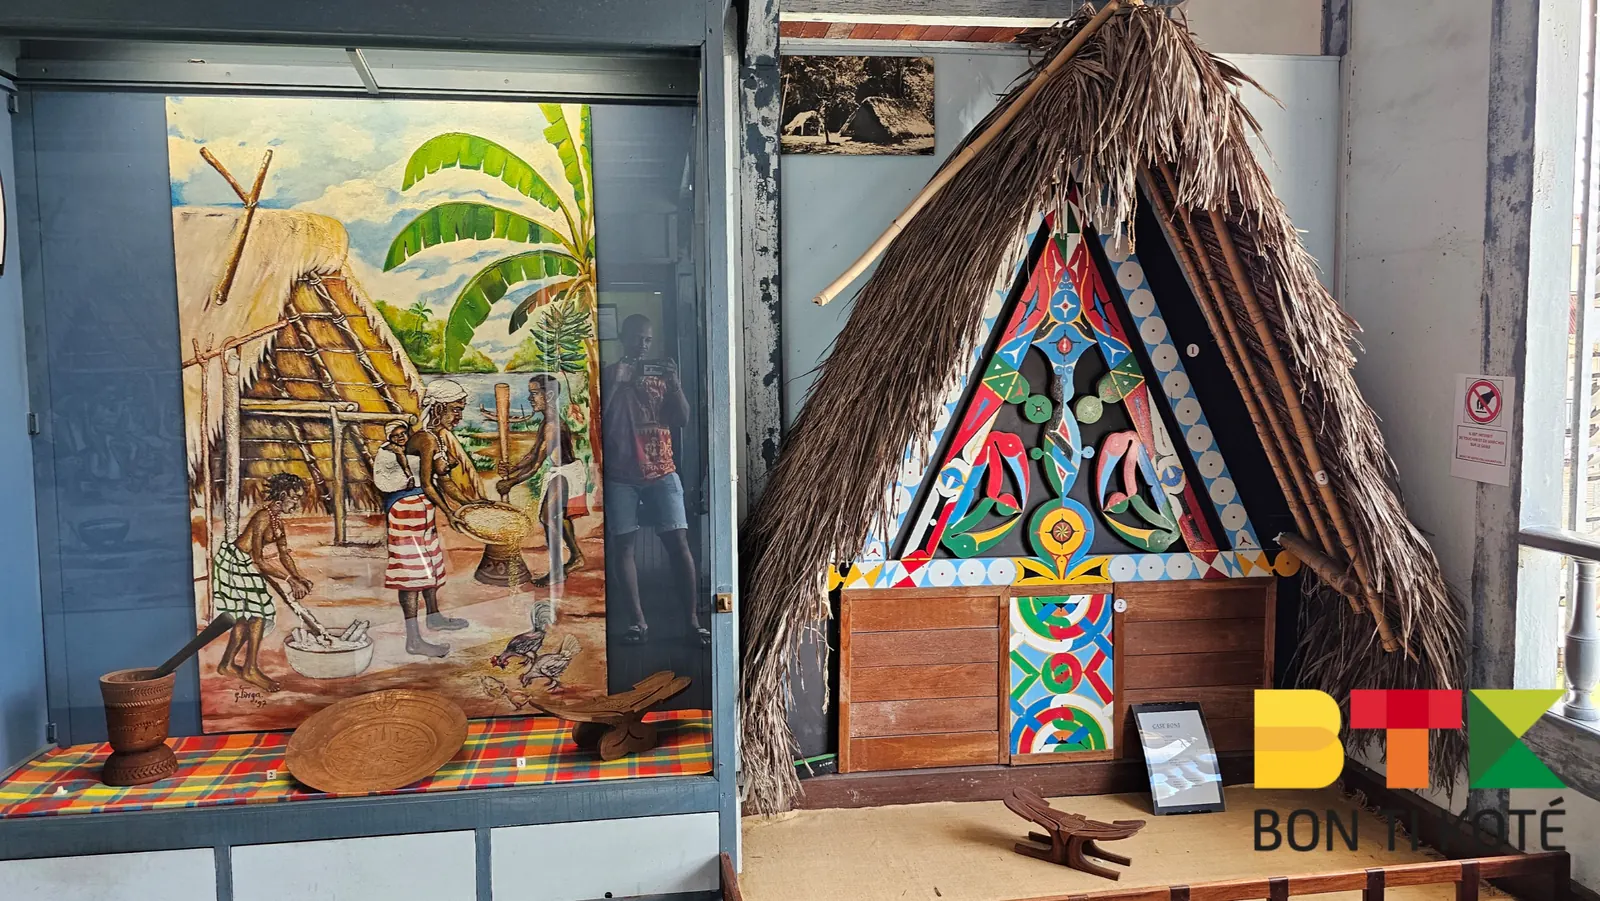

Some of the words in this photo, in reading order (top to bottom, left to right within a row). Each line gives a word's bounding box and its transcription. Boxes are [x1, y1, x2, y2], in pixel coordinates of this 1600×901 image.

[1191, 346, 1195, 355] 1
[1319, 472, 1326, 482] 3
[1118, 601, 1123, 609] 2
